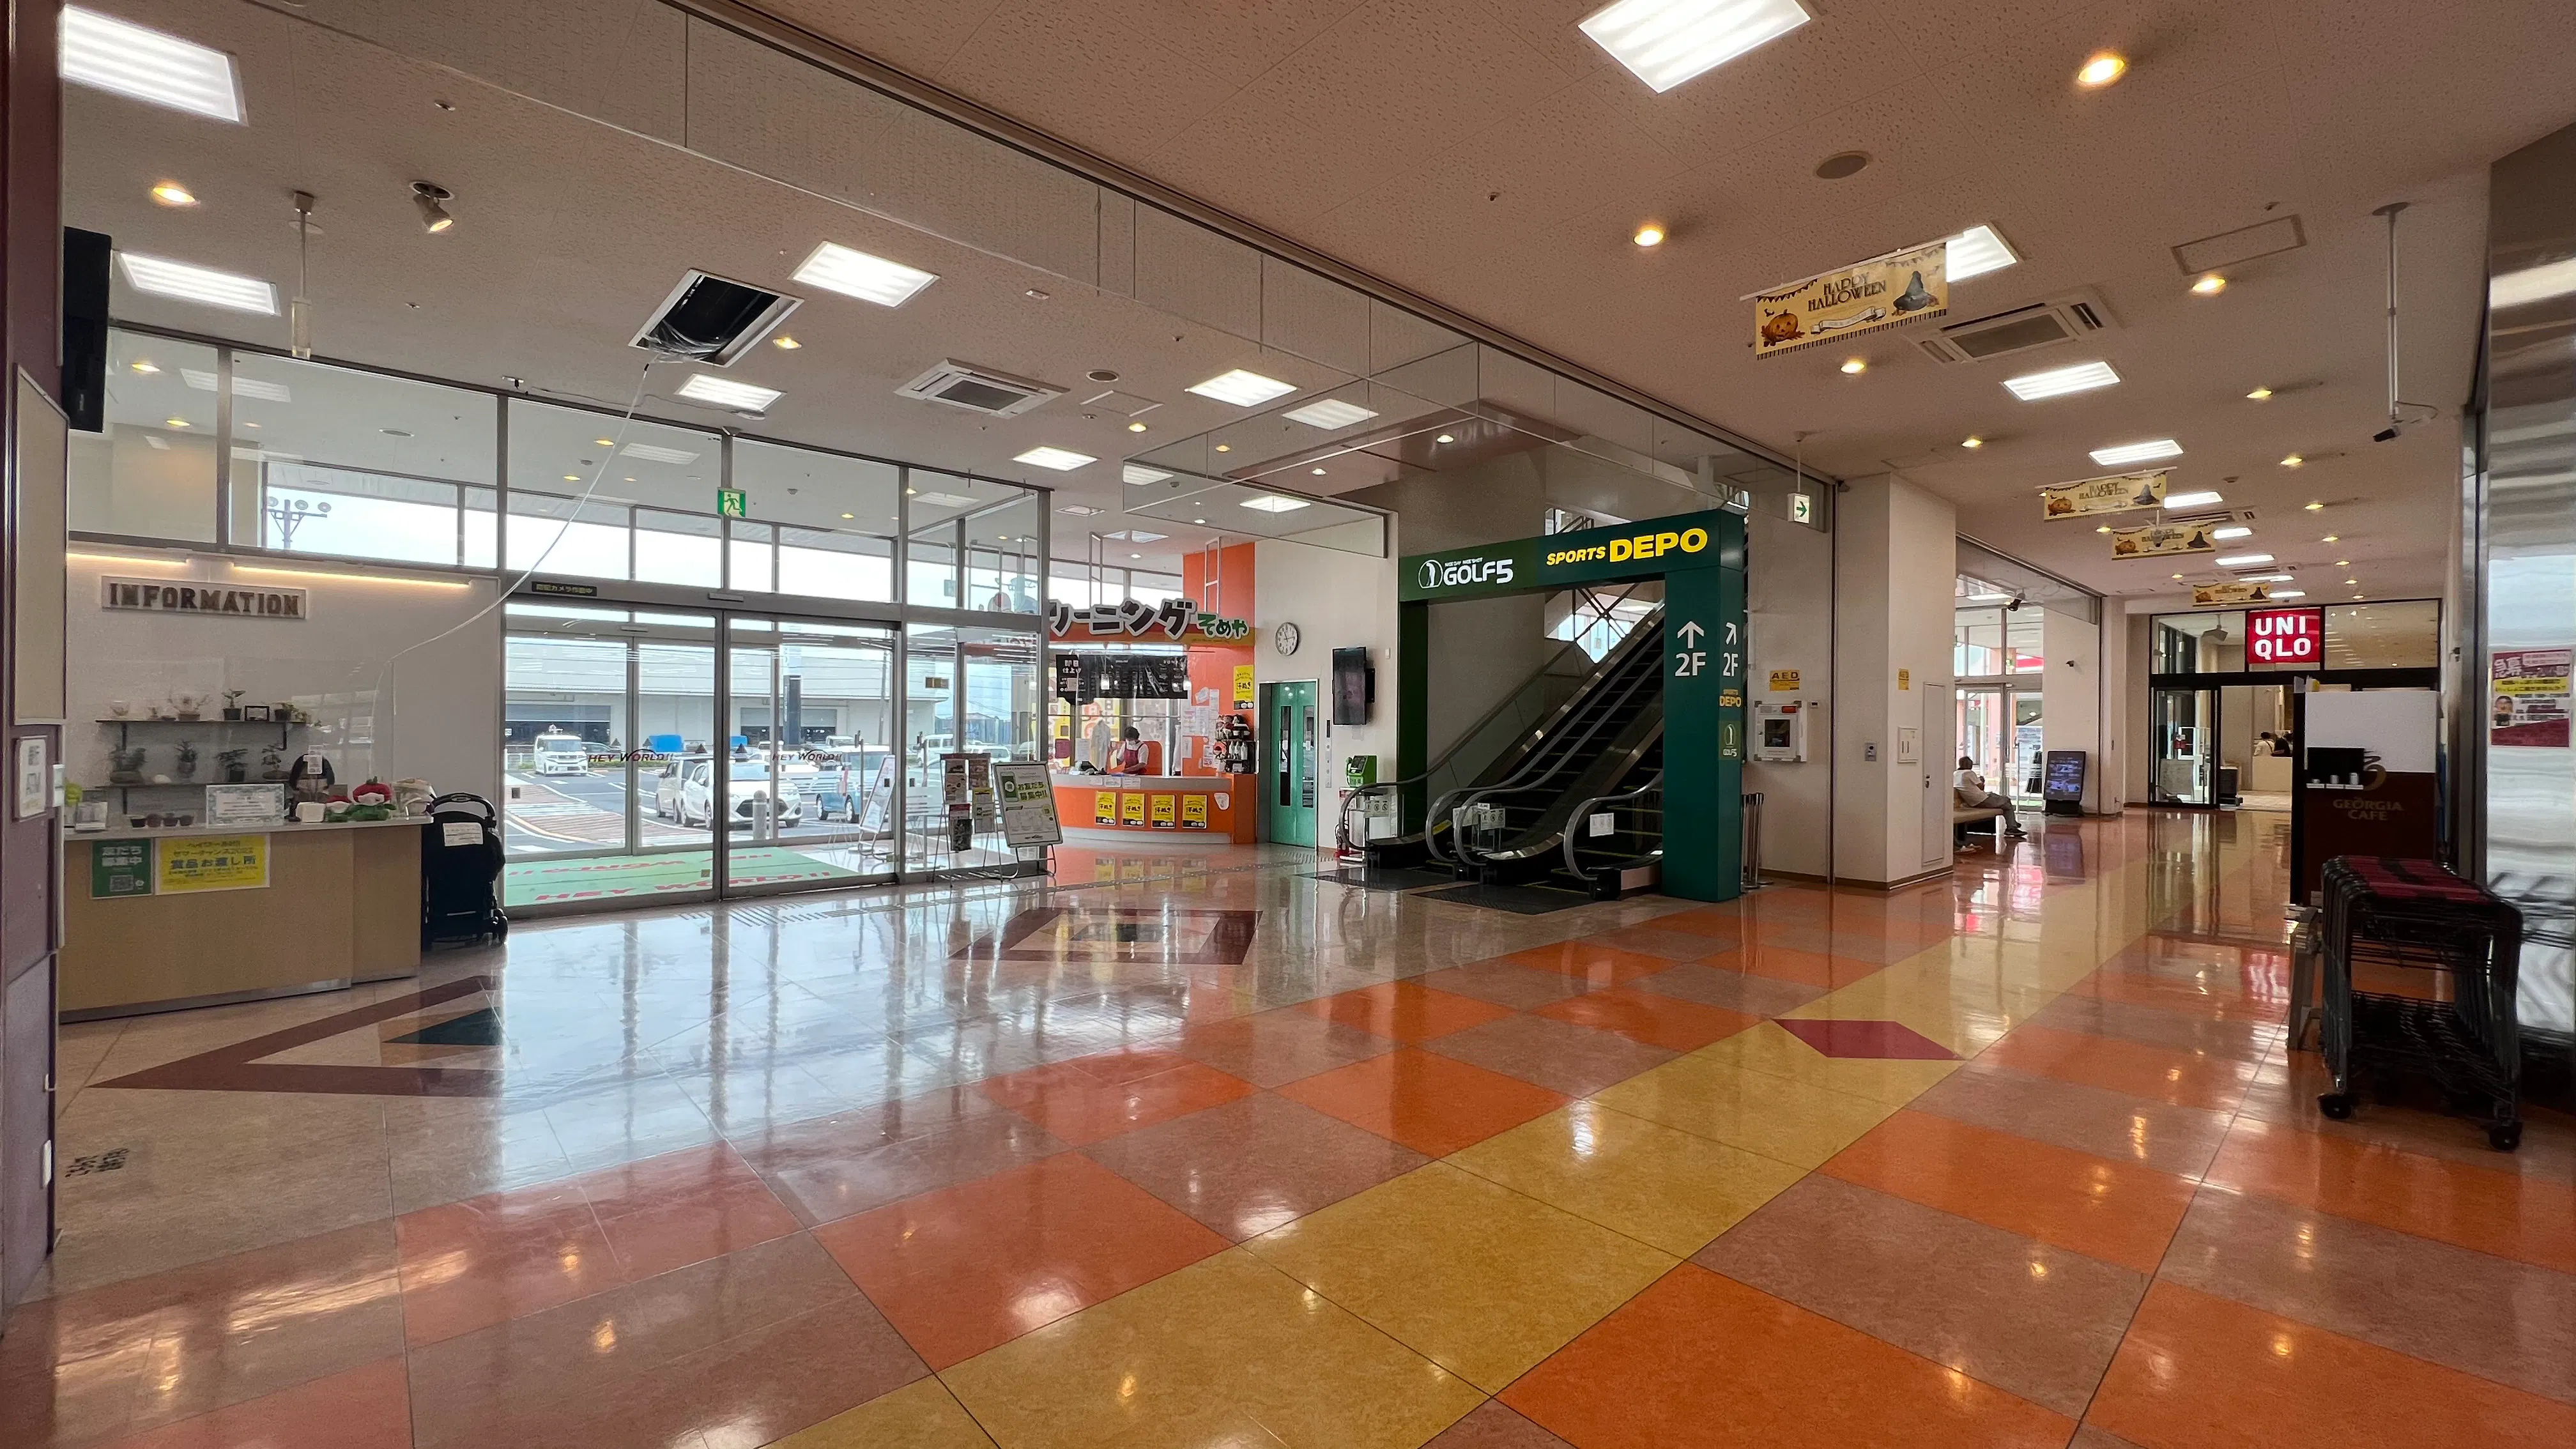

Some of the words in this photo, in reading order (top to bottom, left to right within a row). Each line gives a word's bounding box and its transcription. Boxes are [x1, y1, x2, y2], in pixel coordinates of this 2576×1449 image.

[1823, 272, 1869, 295] HAPPY
[1807, 280, 1886, 312] HALLOWEEN
[2078, 487, 2128, 500] HALLOWEEN
[1546, 546, 1606, 565] SPORTS
[1609, 528, 1708, 563] DEPO
[1444, 559, 1514, 586] GOLF5
[110, 583, 300, 615] INFORMATION
[1197, 613, 1248, 638] そめや
[2255, 616, 2306, 636] UNI
[2255, 638, 2311, 661] QLO
[1675, 652, 1706, 677] 2F
[1723, 653, 1738, 677] 2F
[2494, 657, 2522, 678] 急募
[1719, 696, 1741, 708] DEPO
[2333, 797, 2404, 811] GEORGIA
[534, 887, 636, 901] HEY
